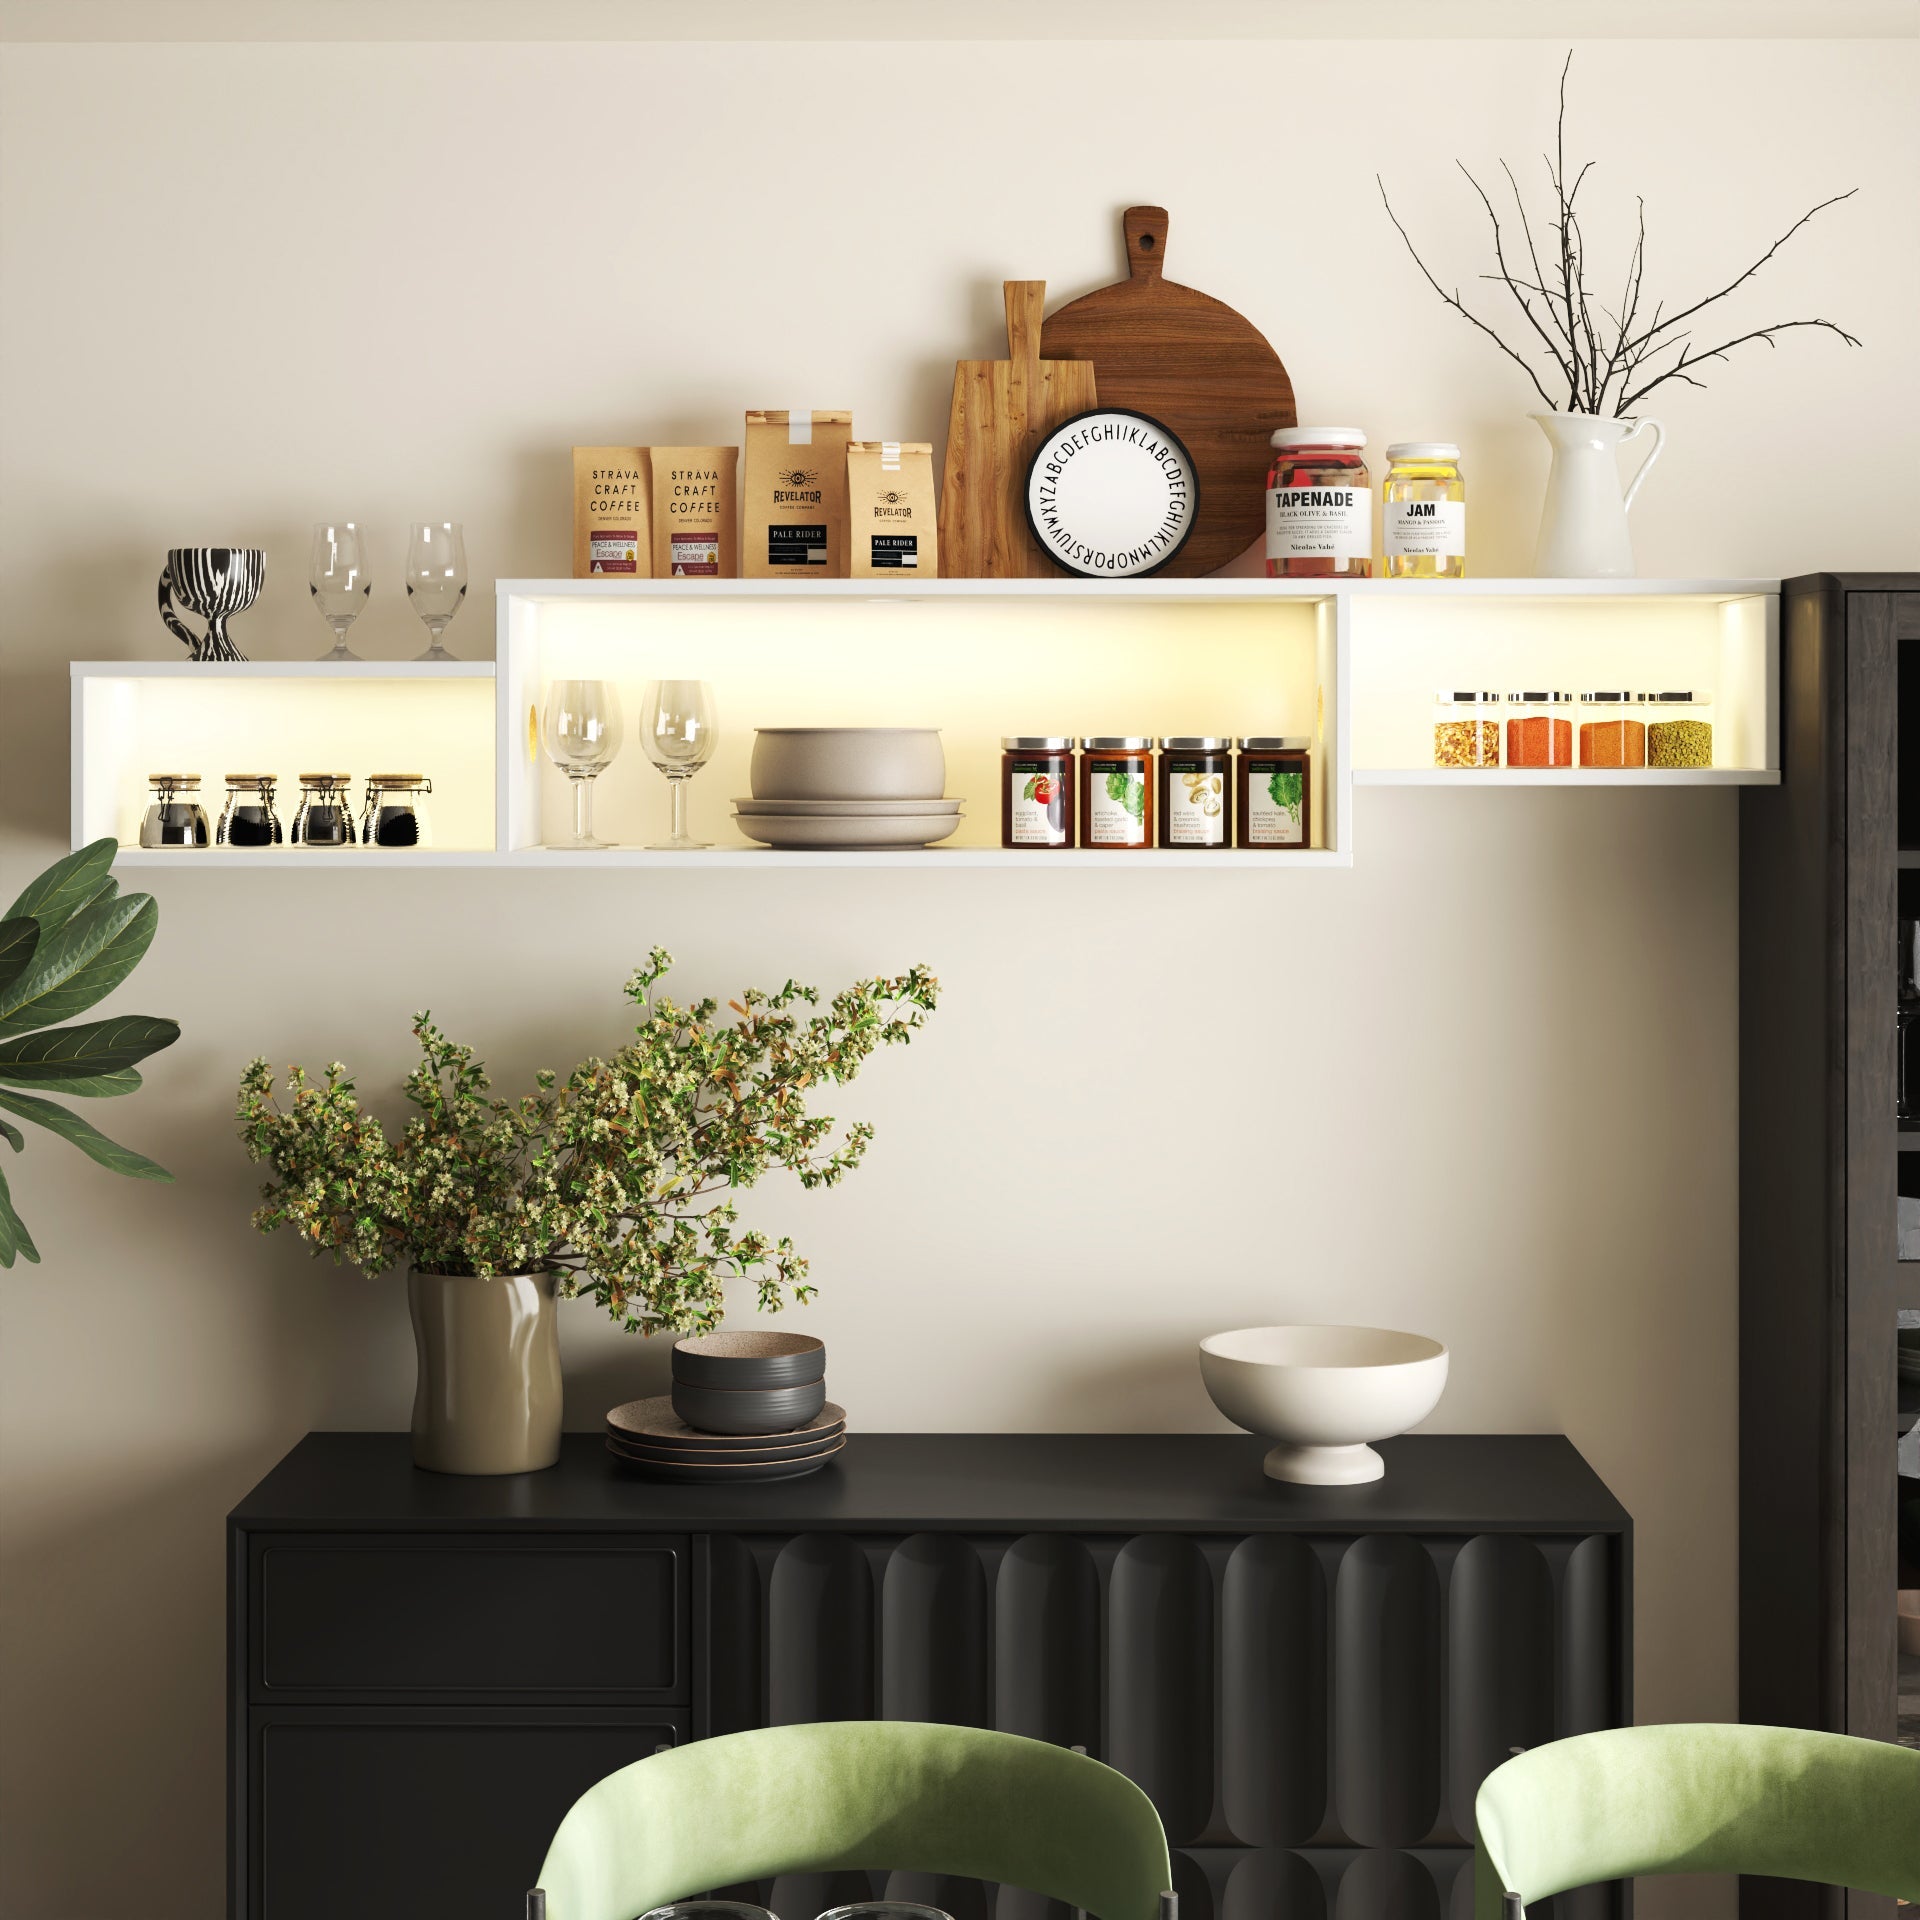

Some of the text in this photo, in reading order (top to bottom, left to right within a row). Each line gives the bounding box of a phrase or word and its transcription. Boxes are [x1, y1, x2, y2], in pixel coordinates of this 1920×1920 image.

[595, 484, 636, 494] CRAFT
[674, 486, 716, 496] CRAFT
[774, 490, 821, 503] REVELATOR
[1276, 492, 1353, 508] TAPENADE
[590, 500, 640, 512] COFFEE
[670, 502, 720, 513] COFFEE
[1406, 504, 1435, 516] JAM
[874, 507, 912, 518] REVELATOR
[596, 549, 622, 558] Escape
[678, 552, 704, 561] Escape
